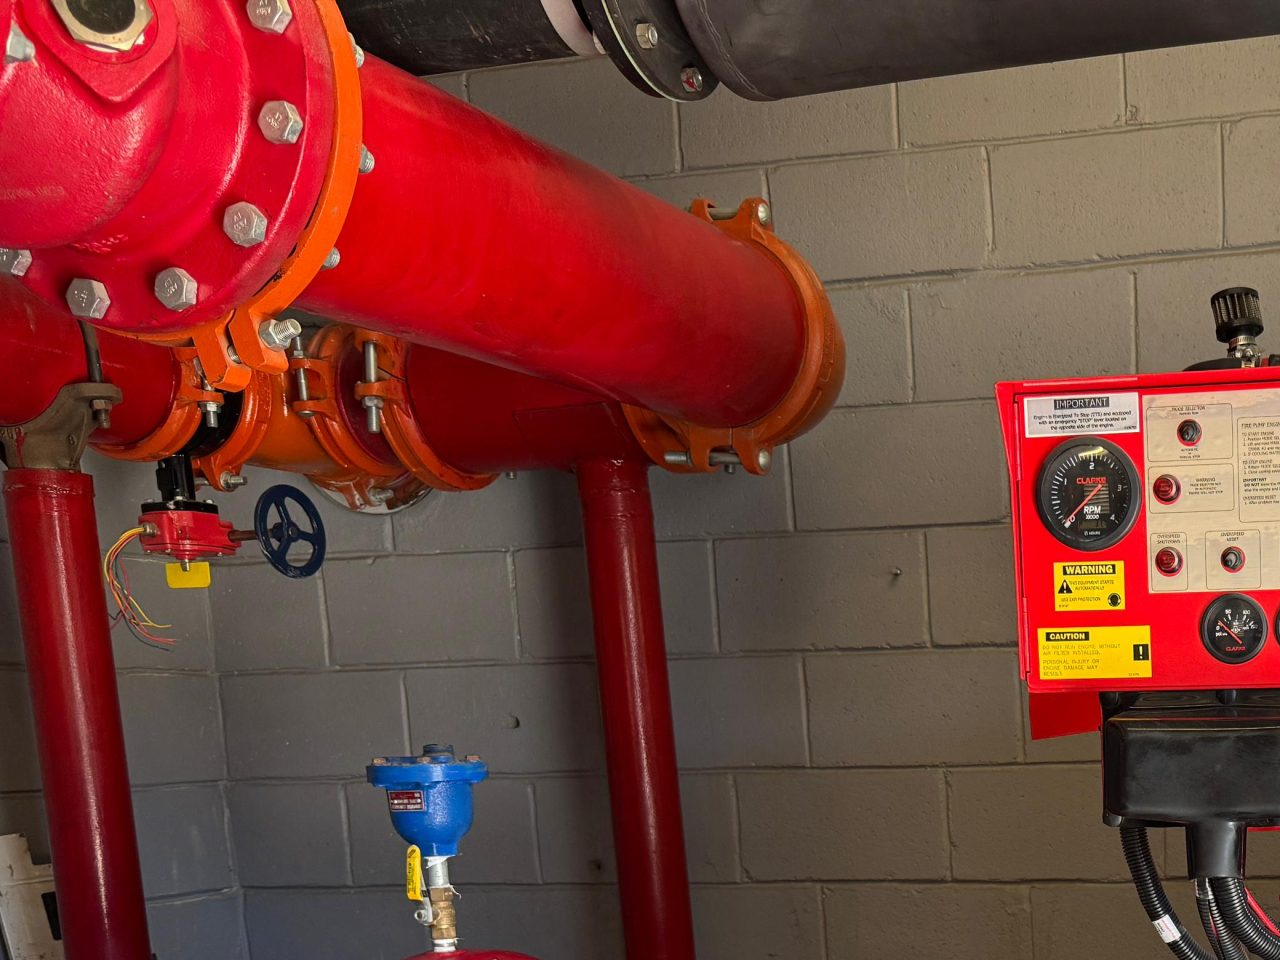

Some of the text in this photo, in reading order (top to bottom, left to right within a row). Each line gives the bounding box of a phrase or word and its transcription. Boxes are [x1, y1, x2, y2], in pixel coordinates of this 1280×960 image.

[1056, 398, 1108, 409] IMPORTANT
[1084, 506, 1101, 515] RPM
[1065, 565, 1113, 575] WARNING
[1050, 632, 1086, 640] CAUTION
